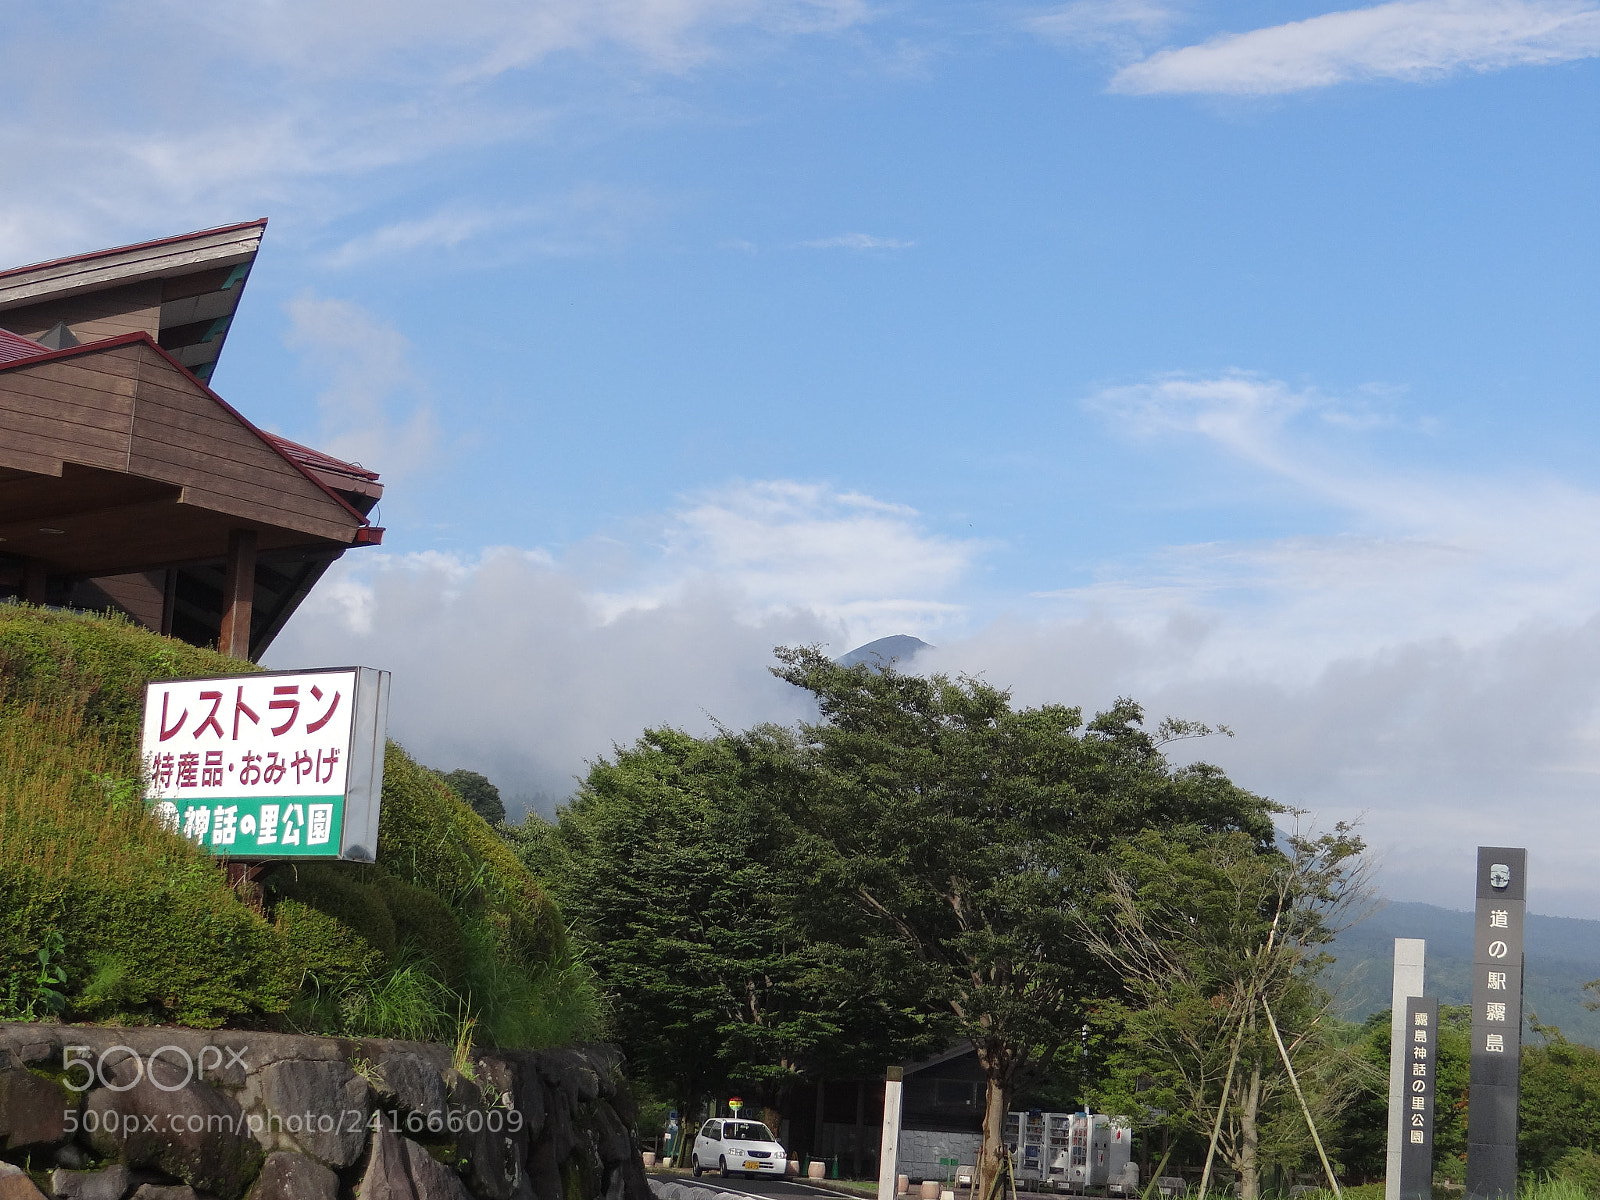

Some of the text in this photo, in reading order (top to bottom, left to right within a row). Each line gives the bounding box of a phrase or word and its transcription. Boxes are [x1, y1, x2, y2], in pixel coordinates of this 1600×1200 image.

[159, 684, 341, 742] レストラン
[152, 747, 341, 789] 特産品・おみやげ
[183, 803, 334, 846] 神話の里公園
[1485, 909, 1509, 1053] 道の駅霧島
[1410, 1012, 1428, 1144] 霧島神話の里公園
